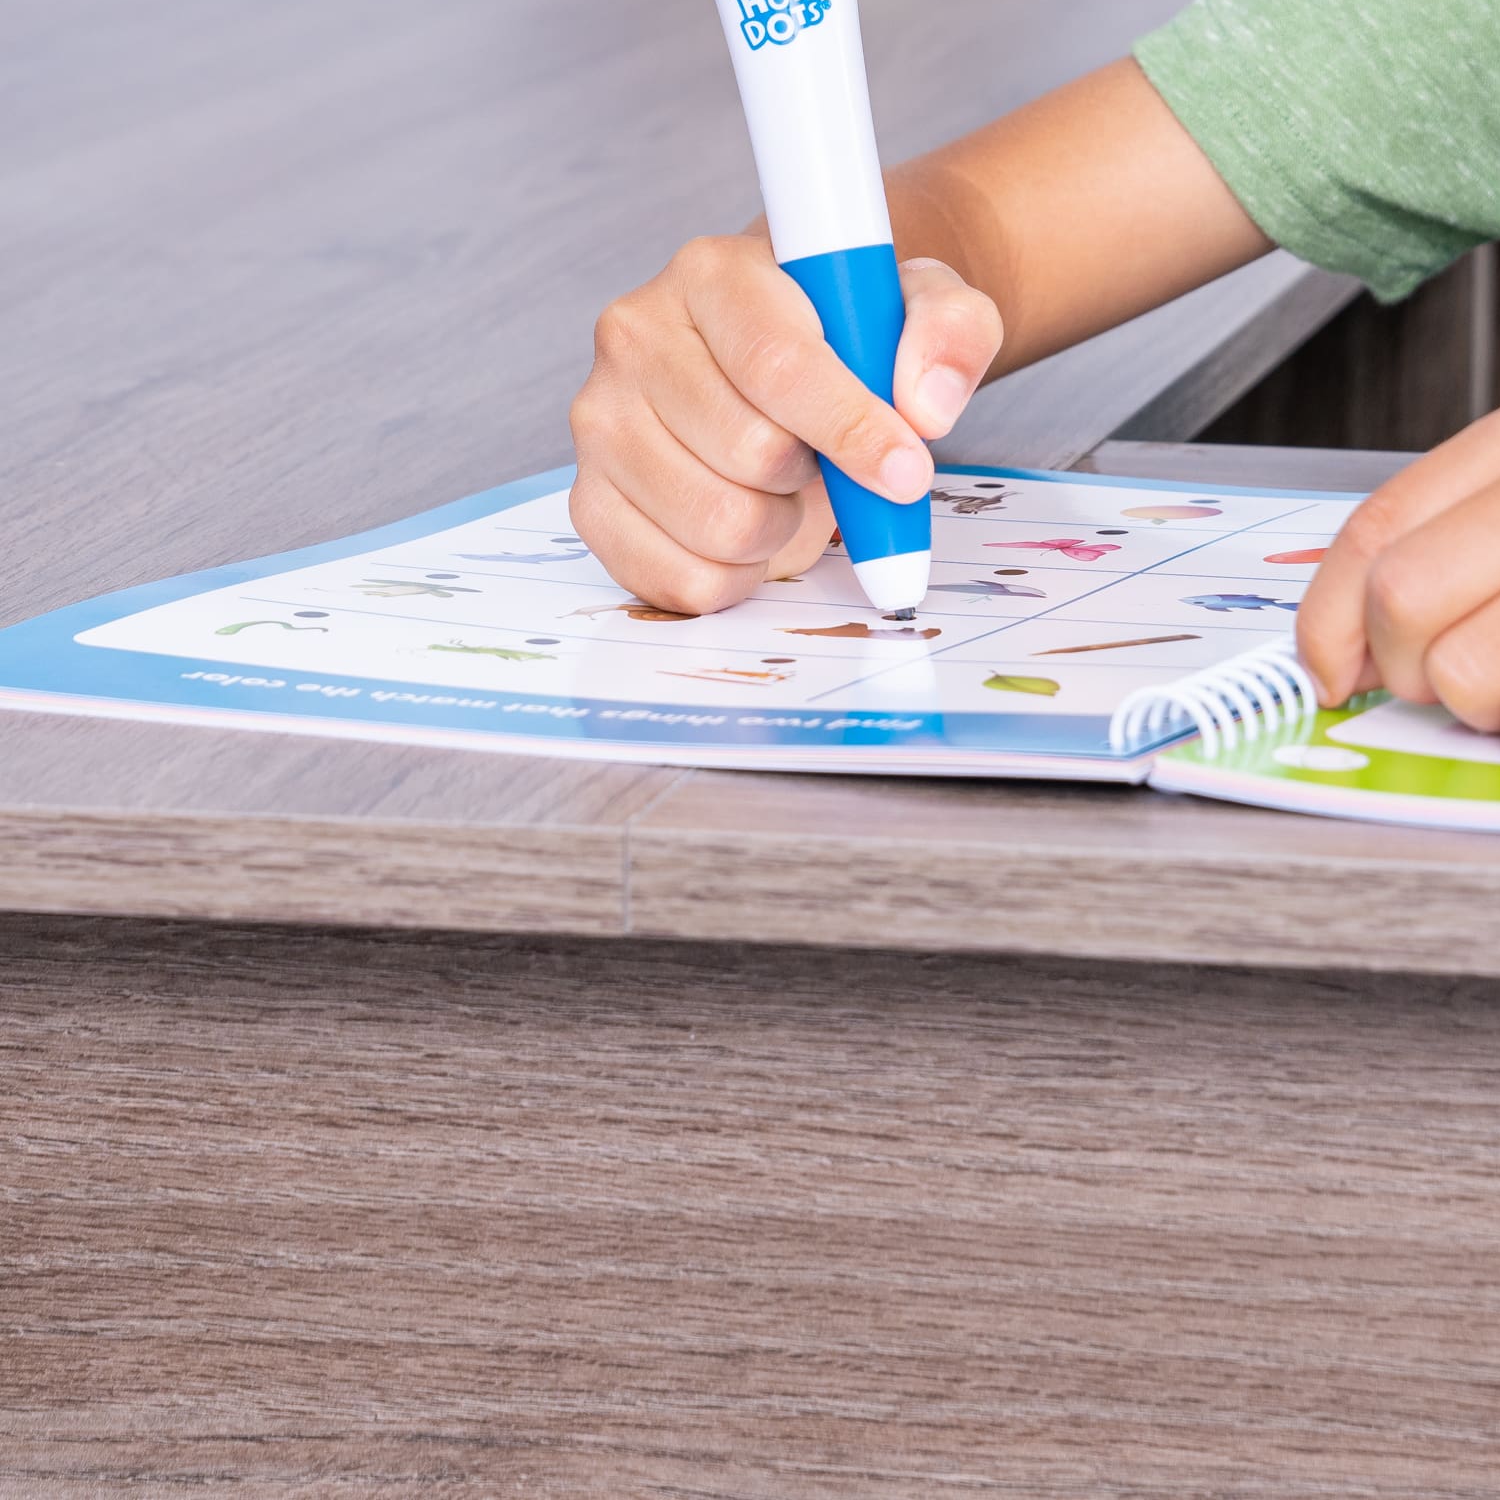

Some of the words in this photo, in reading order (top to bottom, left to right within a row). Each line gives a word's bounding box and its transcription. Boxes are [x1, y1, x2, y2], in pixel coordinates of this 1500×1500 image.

[180, 671, 287, 688] color
[296, 683, 362, 697] the
[370, 690, 497, 709] match
[502, 703, 590, 719] that
[599, 710, 727, 726] things
[737, 716, 822, 728] two
[825, 718, 923, 730] Find
